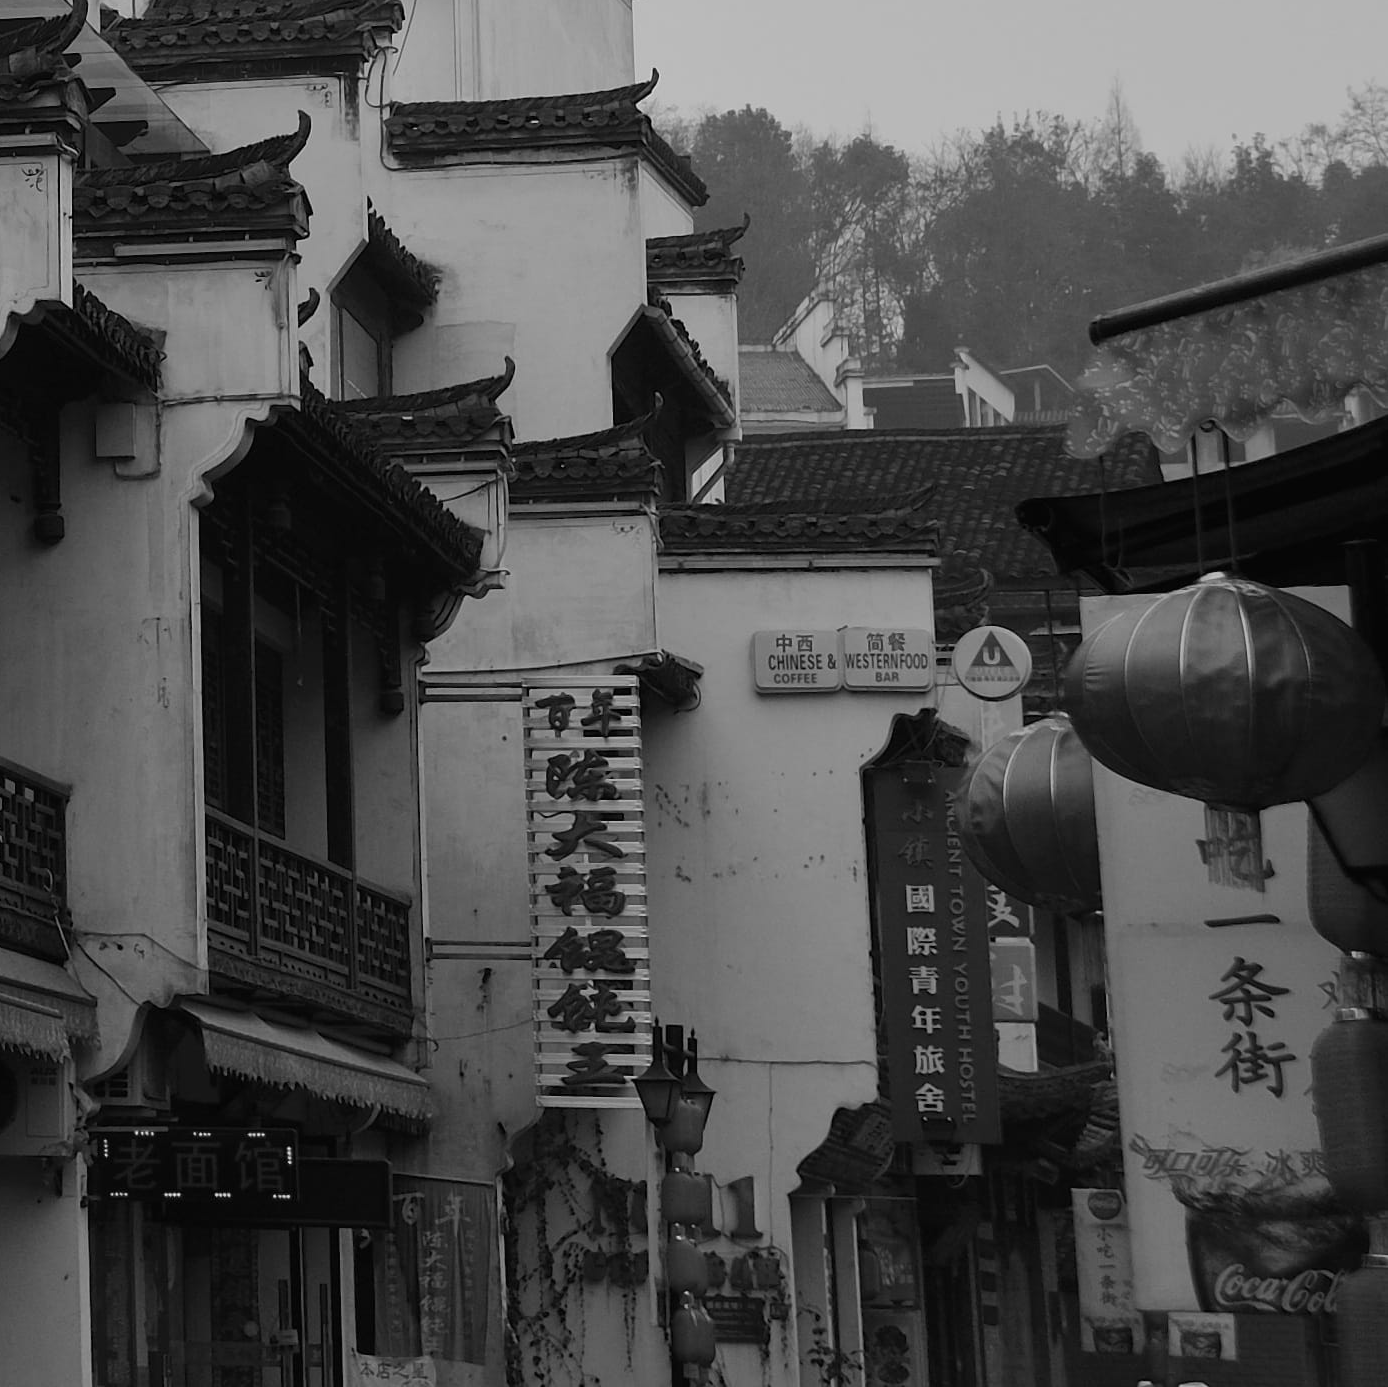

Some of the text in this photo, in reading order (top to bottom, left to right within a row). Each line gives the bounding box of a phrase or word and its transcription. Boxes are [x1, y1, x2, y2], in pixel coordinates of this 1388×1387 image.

[775, 632, 907, 653] 中西 简餐
[768, 653, 823, 670] CHINESE
[827, 653, 837, 669] &
[773, 671, 900, 684] COFFEE BAR
[943, 788, 979, 1125] ANCIENT TOWN YOUTH HOSTEL
[114, 1140, 285, 1192] 老面馆
[1214, 1263, 1346, 1313] Coca-Col
